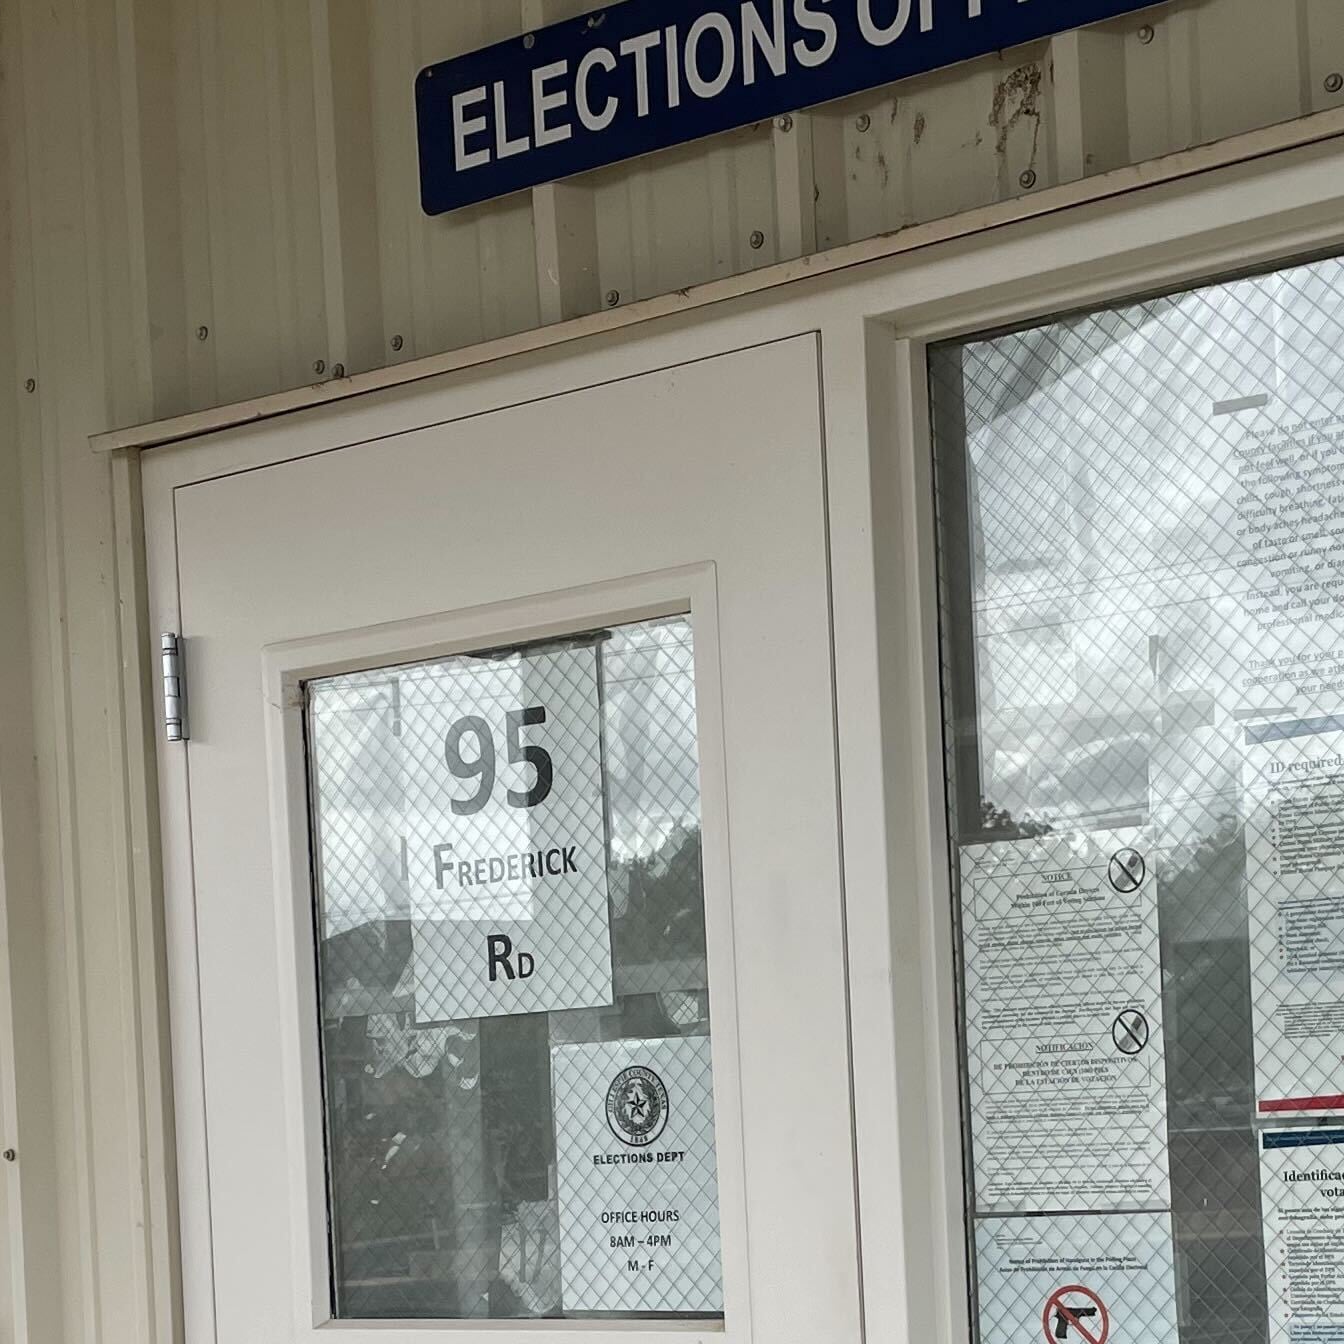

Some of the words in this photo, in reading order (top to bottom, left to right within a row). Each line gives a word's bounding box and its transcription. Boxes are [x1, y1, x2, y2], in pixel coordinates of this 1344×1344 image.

[451, 0, 838, 171] ELECTIONS
[1285, 586, 1302, 595] you
[1244, 606, 1269, 616] home
[1272, 603, 1288, 612] and
[1291, 598, 1306, 608] call
[1309, 597, 1330, 609] your
[1296, 684, 1317, 694] your
[444, 706, 553, 816] 95
[1271, 762, 1283, 773] ID
[1287, 754, 1342, 772] required
[433, 843, 577, 889] FREDERICK
[594, 1153, 654, 1165] ELECTIONS
[657, 1152, 685, 1162] DEPT
[601, 1211, 638, 1224] OFFICE
[640, 1210, 679, 1223] HOURS
[610, 1235, 635, 1248] 8AM
[647, 1235, 671, 1247] 4PM
[627, 1260, 639, 1272] M
[648, 1260, 655, 1271] F
